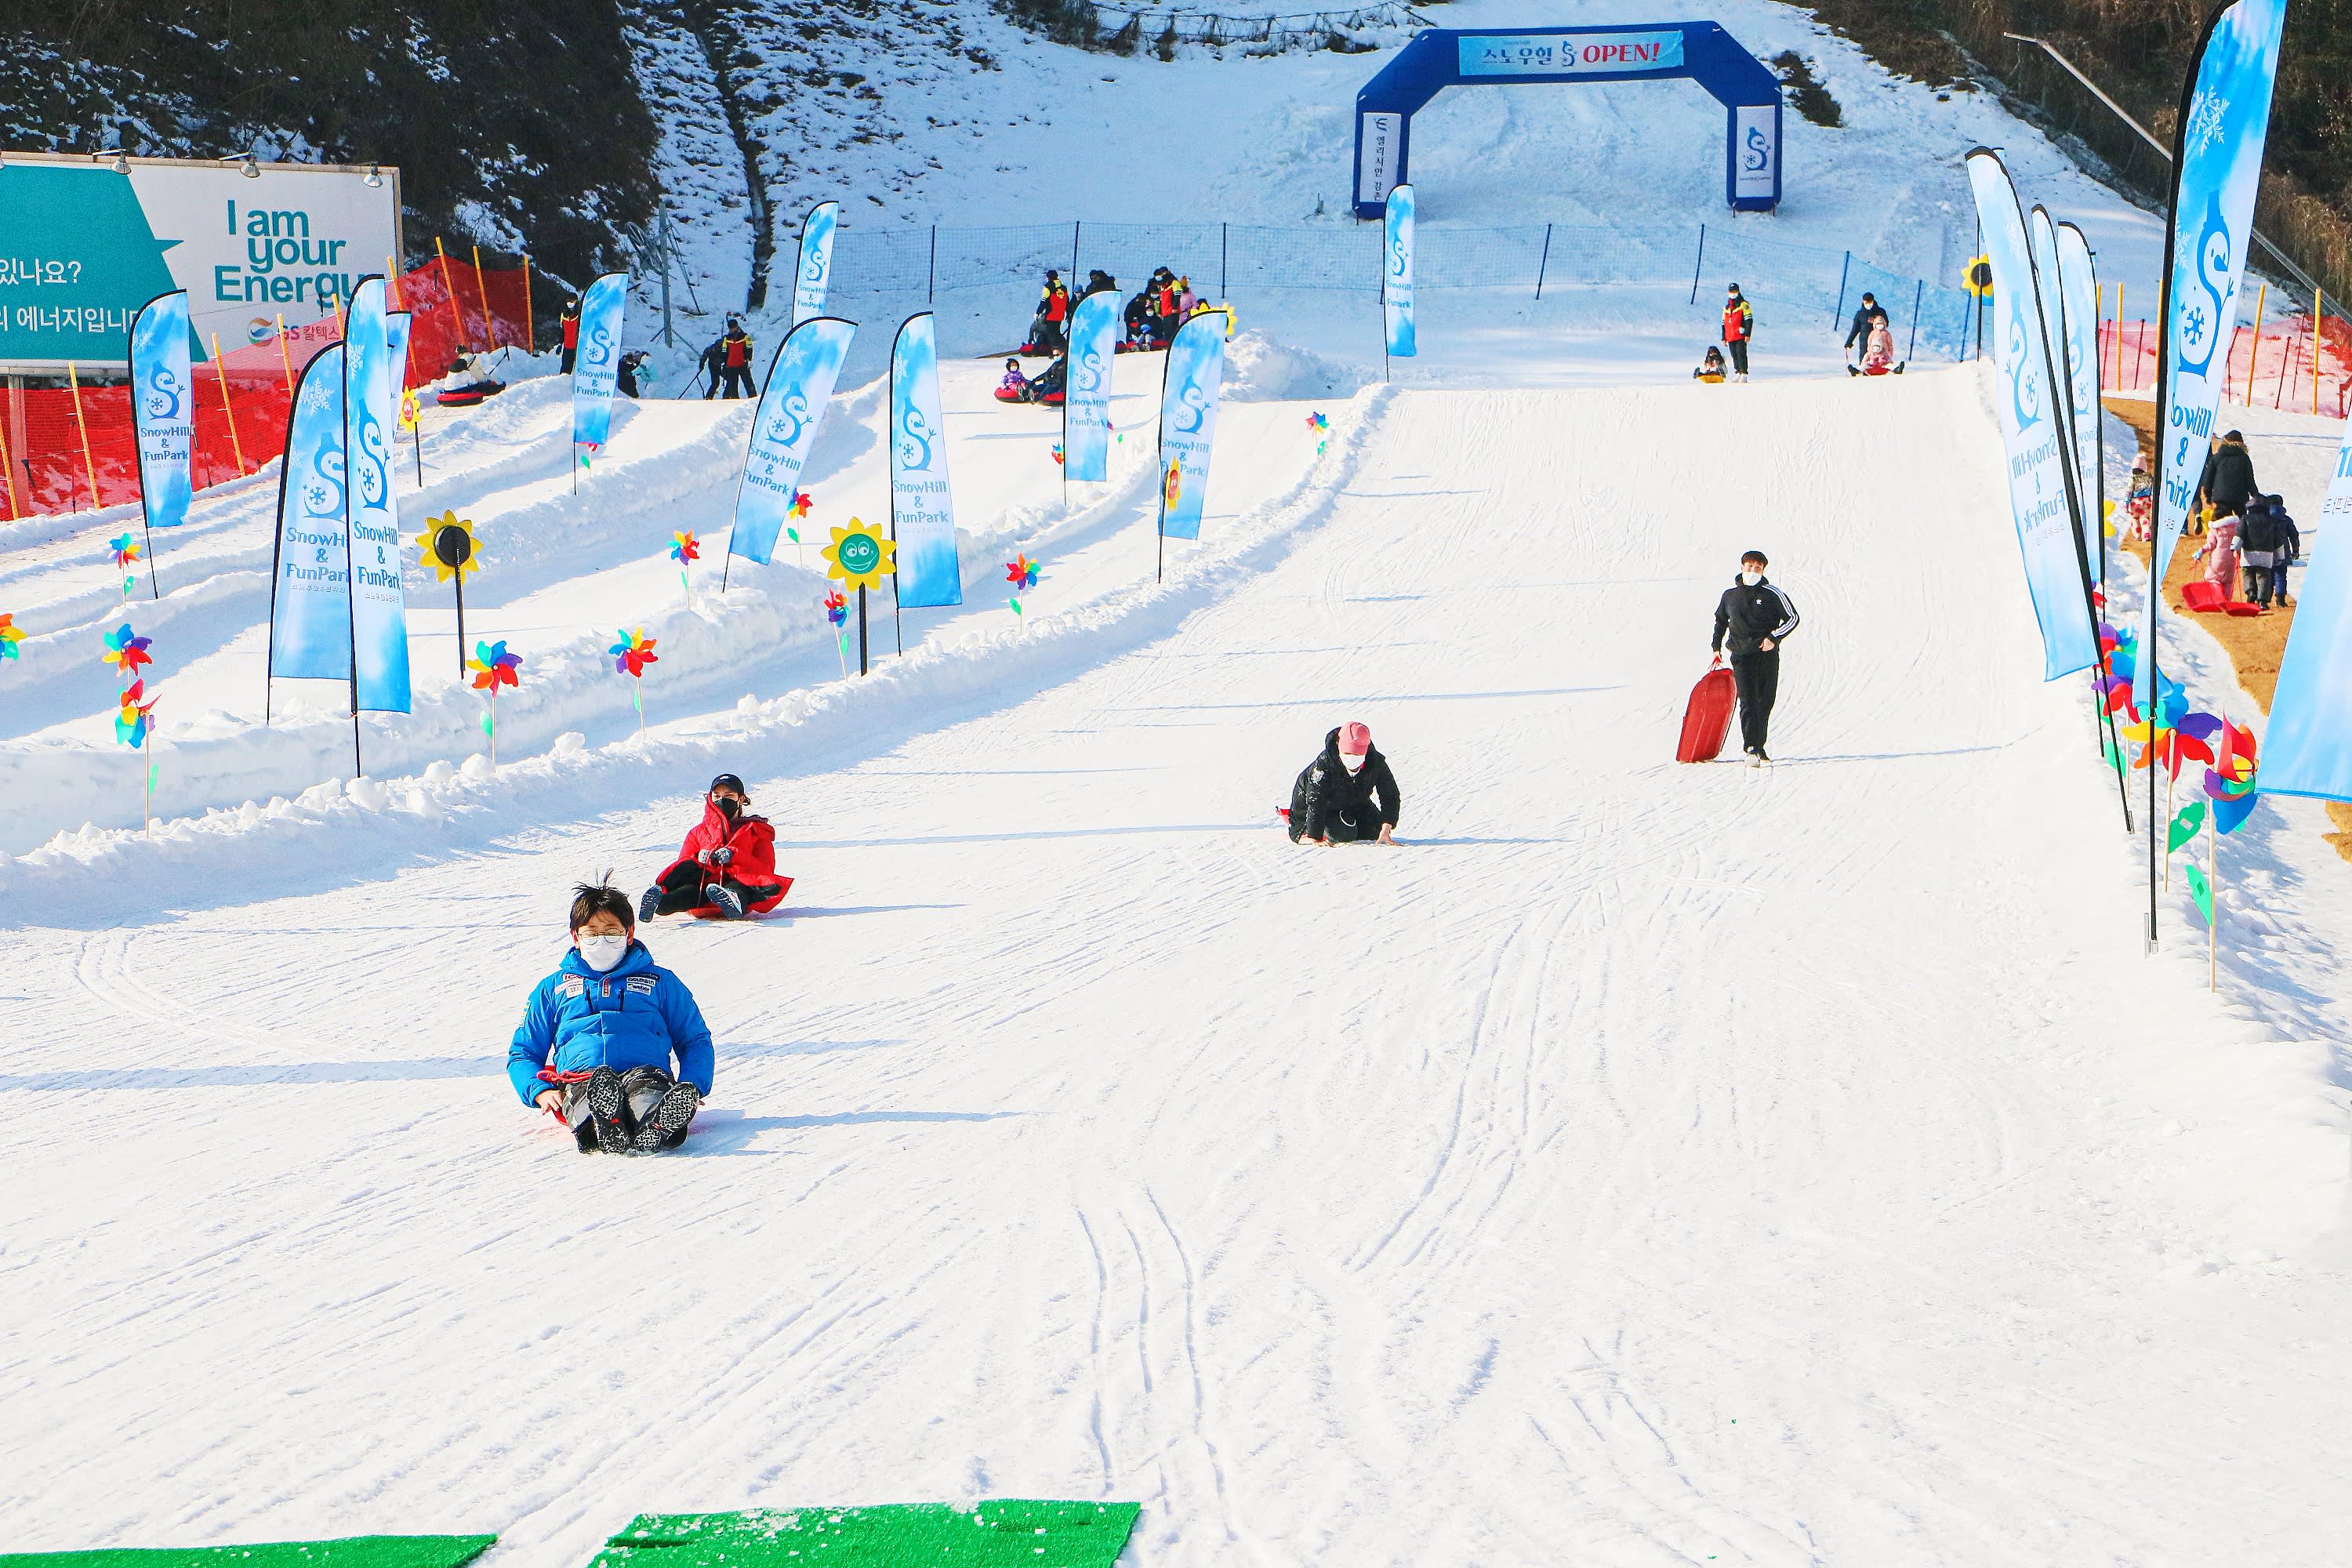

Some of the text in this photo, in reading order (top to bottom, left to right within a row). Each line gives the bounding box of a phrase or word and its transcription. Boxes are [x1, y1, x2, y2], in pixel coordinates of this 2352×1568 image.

[1583, 42, 1661, 64] OPEN!
[227, 200, 309, 237] I am
[248, 238, 347, 274] your
[141, 426, 190, 437] SnowHill
[162, 438, 169, 448] &
[144, 451, 188, 461] FunPark
[750, 445, 800, 471] SnowHill
[1179, 452, 1186, 462] &
[765, 464, 774, 475] &
[894, 481, 946, 493] SnowHill
[914, 495, 924, 508] &
[896, 510, 948, 523] FunPark
[286, 527, 345, 547] SnowH
[354, 521, 397, 546] SnowHill
[316, 548, 328, 563] &
[377, 546, 386, 564] &
[358, 566, 401, 590] FunPark
